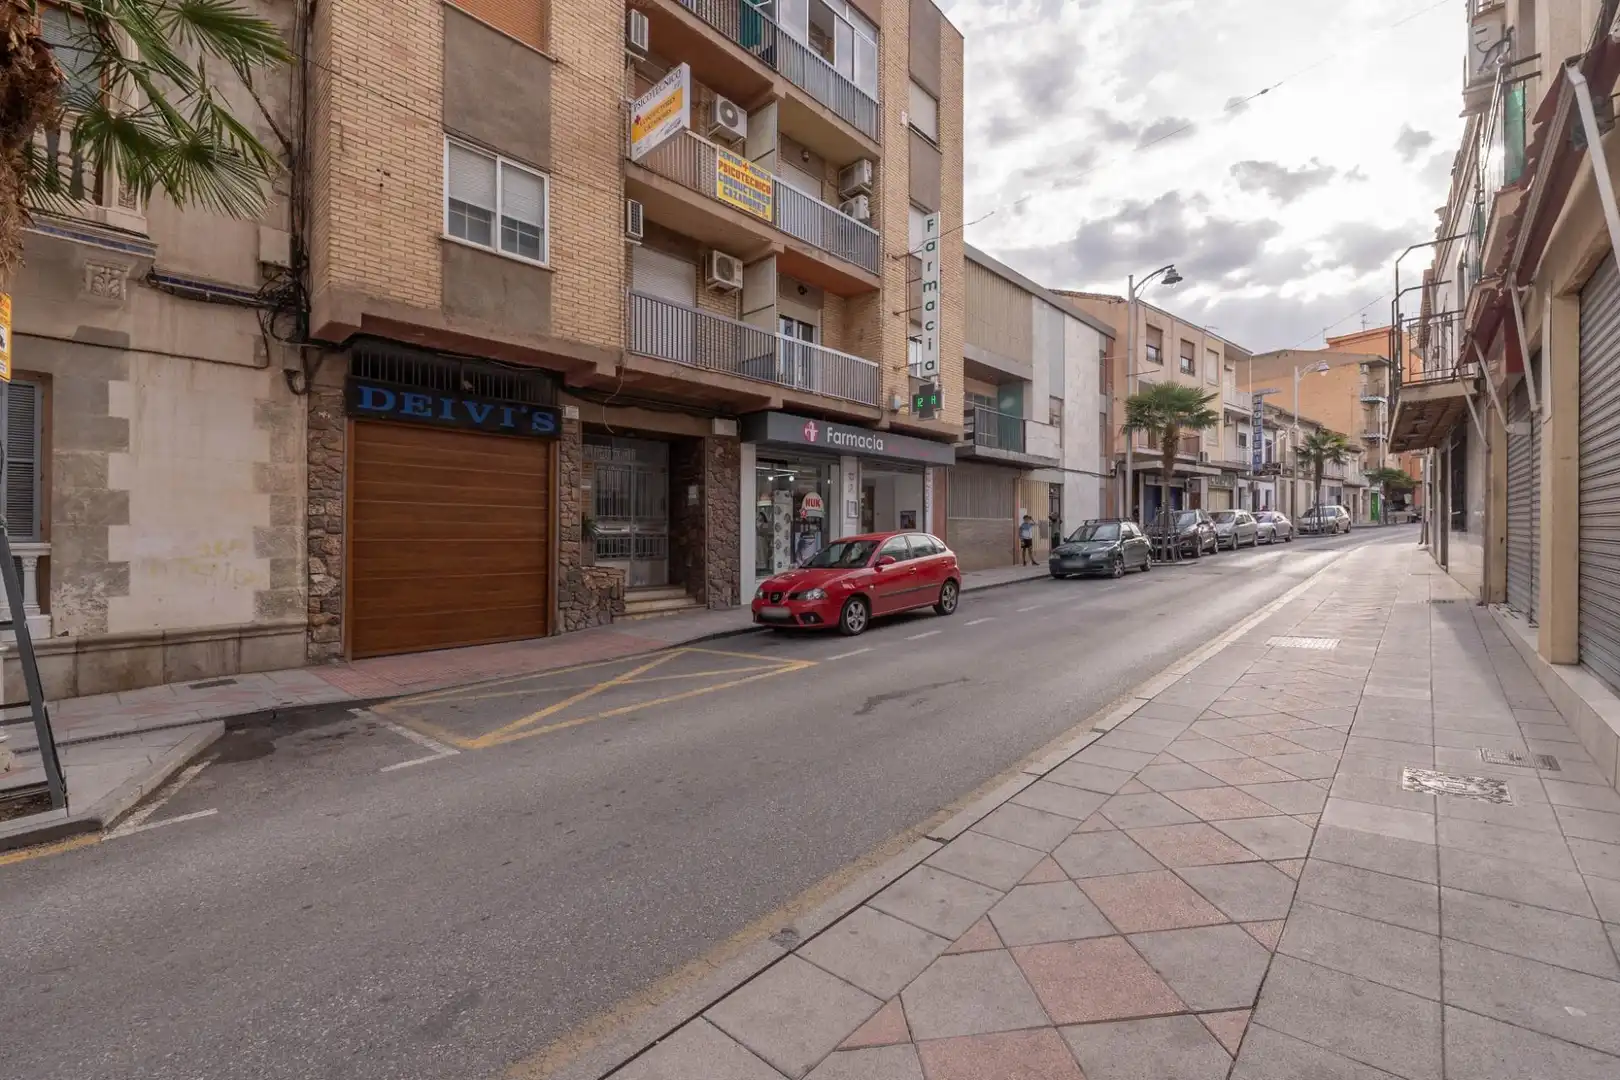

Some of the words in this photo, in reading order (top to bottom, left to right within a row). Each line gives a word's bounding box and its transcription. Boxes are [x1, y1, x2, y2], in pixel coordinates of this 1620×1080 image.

[633, 68, 681, 113] PSICOTECNICO
[718, 160, 771, 195] PSICOTECNICO
[923, 219, 937, 371] Farmacia
[357, 385, 556, 432] DEIVI'S
[826, 426, 884, 451] Farmacia
[805, 497, 821, 509] NUK
